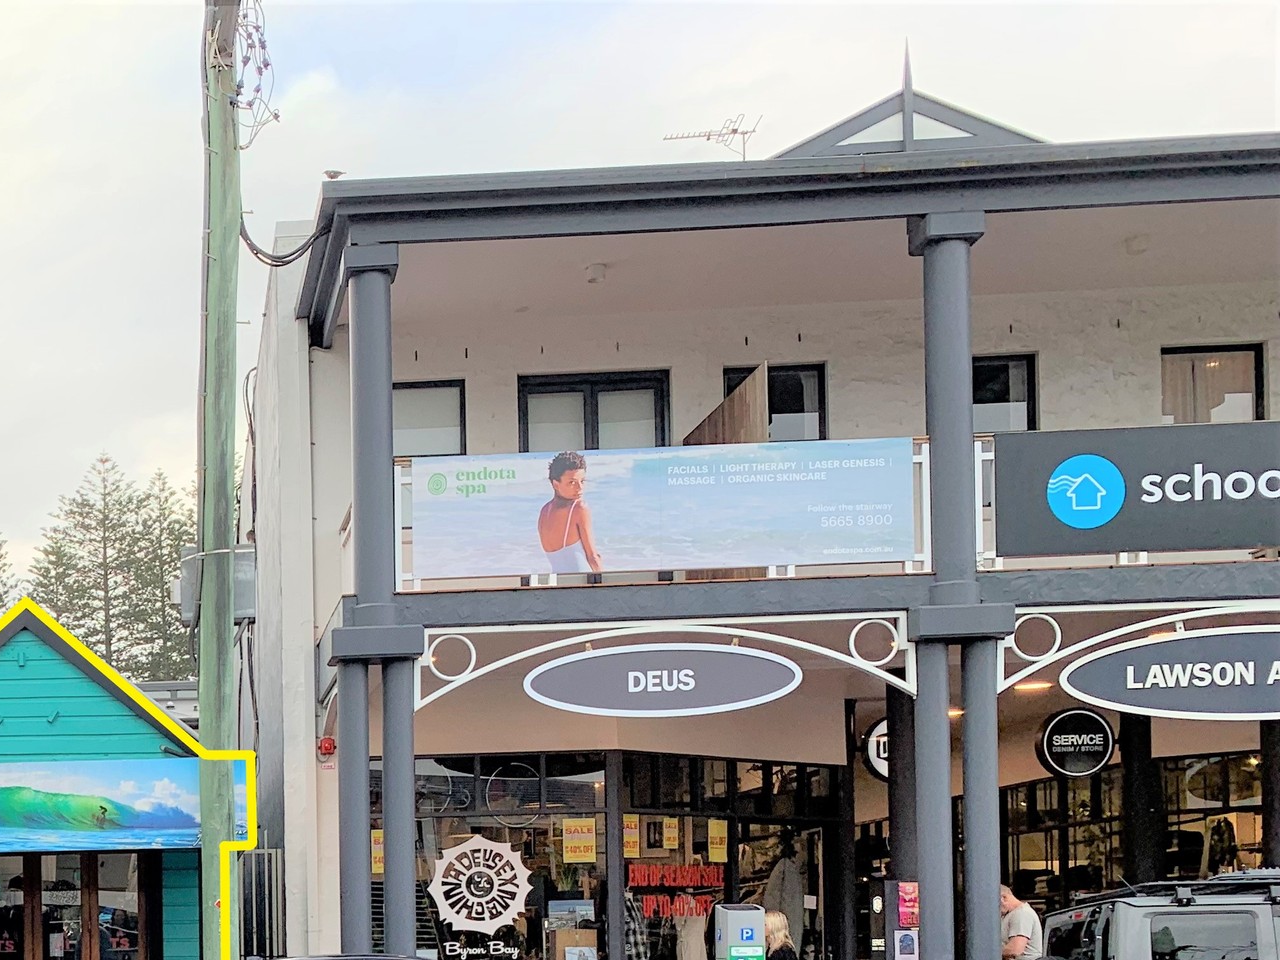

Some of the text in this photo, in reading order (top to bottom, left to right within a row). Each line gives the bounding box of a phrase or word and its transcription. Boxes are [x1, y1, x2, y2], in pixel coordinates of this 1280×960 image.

[455, 466, 517, 482] endota
[667, 458, 886, 475] FACIALS LIGHT THERAPY LASER GENESIS
[667, 471, 827, 486] MASSAGE ORGANIC SKINCARE
[455, 483, 487, 498] spa
[807, 502, 893, 513] Follow the stairway
[820, 514, 893, 527] 5665 8900
[823, 545, 894, 555] endotaspa.com.au
[627, 669, 696, 693] DEUS
[1126, 660, 1255, 690] LAWSON
[1052, 733, 1104, 746] SERVICE
[564, 827, 594, 835] SALE
[628, 864, 648, 887] END
[663, 864, 701, 887] SEASON
[702, 864, 725, 886] SALE
[443, 940, 520, 960] Byron Bay
